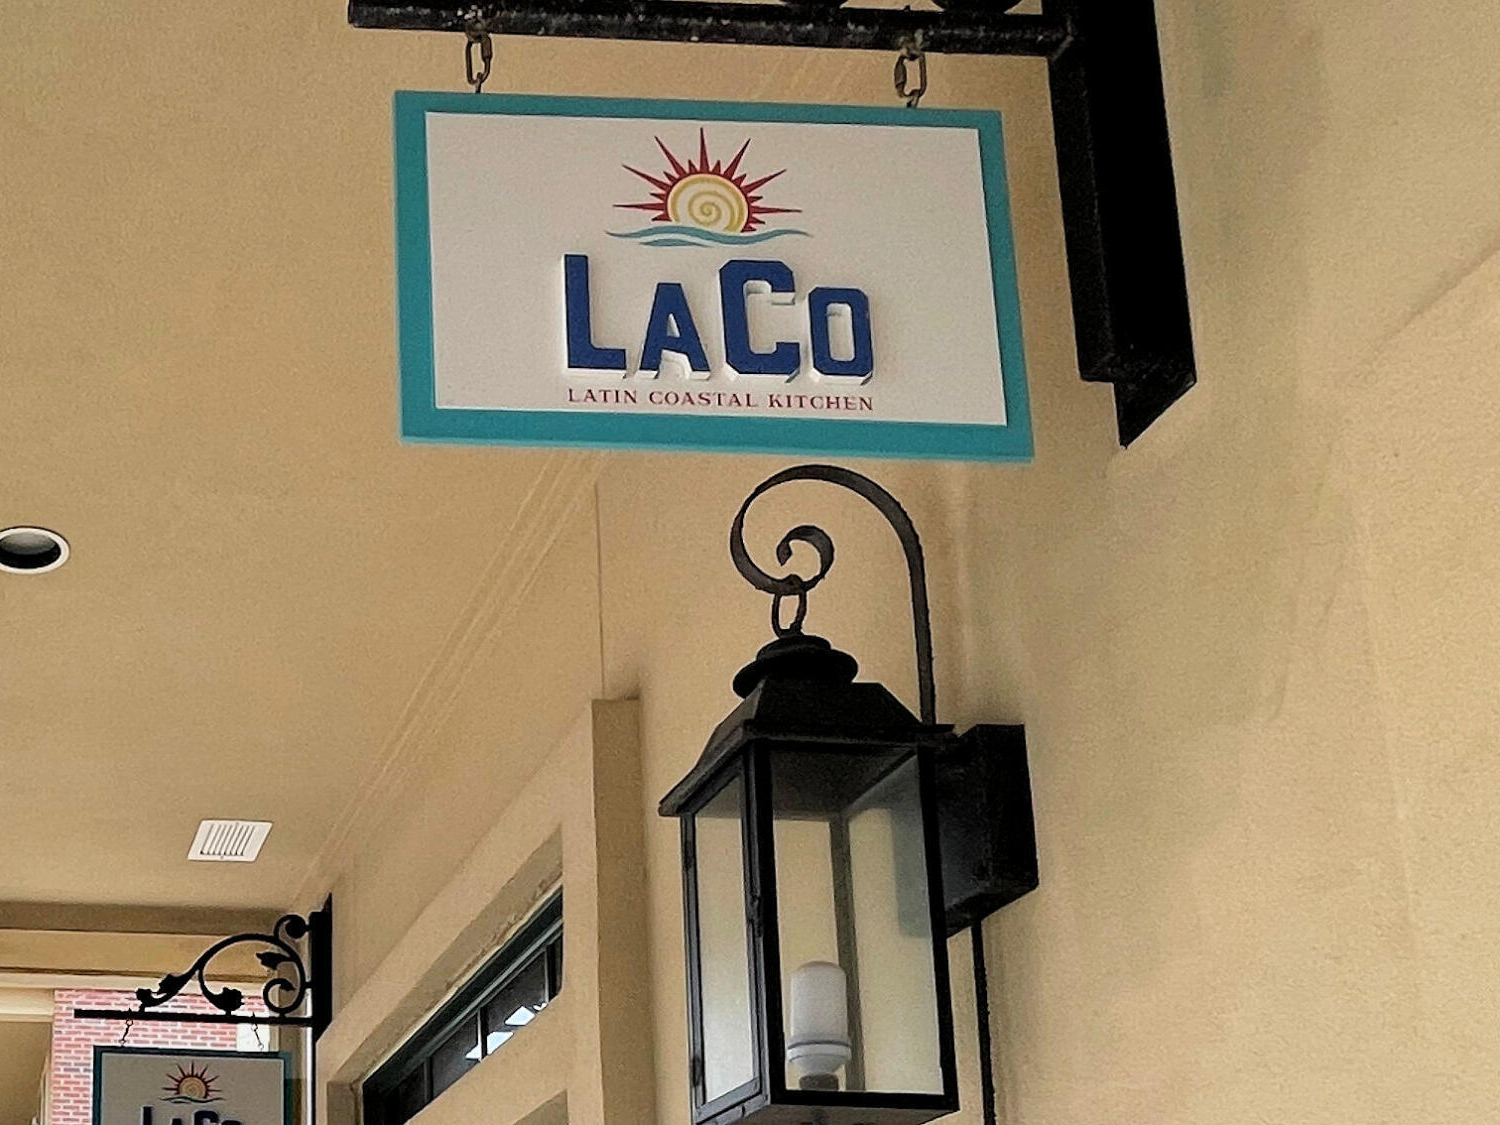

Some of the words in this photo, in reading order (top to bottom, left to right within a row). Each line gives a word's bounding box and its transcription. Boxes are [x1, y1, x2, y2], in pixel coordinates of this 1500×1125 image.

[567, 388, 638, 405] LATIN
[649, 391, 757, 408] COASTAL
[768, 394, 874, 411] KITCHEN
